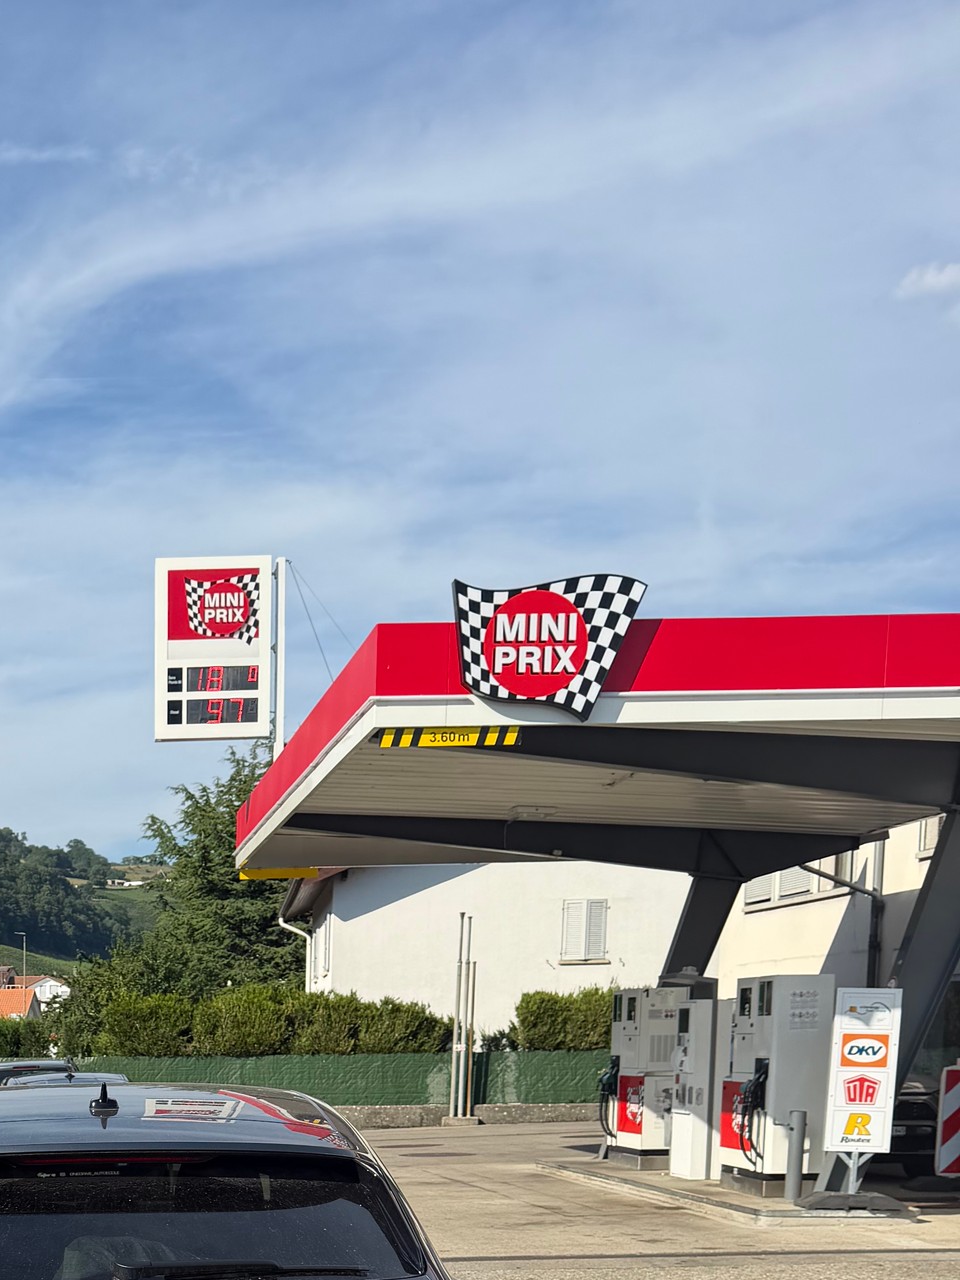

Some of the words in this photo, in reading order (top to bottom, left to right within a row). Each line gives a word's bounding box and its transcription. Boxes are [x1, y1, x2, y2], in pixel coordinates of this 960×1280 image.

[204, 592, 245, 608] MINI
[204, 608, 245, 623] PRIX
[494, 612, 578, 643] MINI
[493, 645, 578, 674] PRIX
[847, 1045, 883, 1056] DKV
